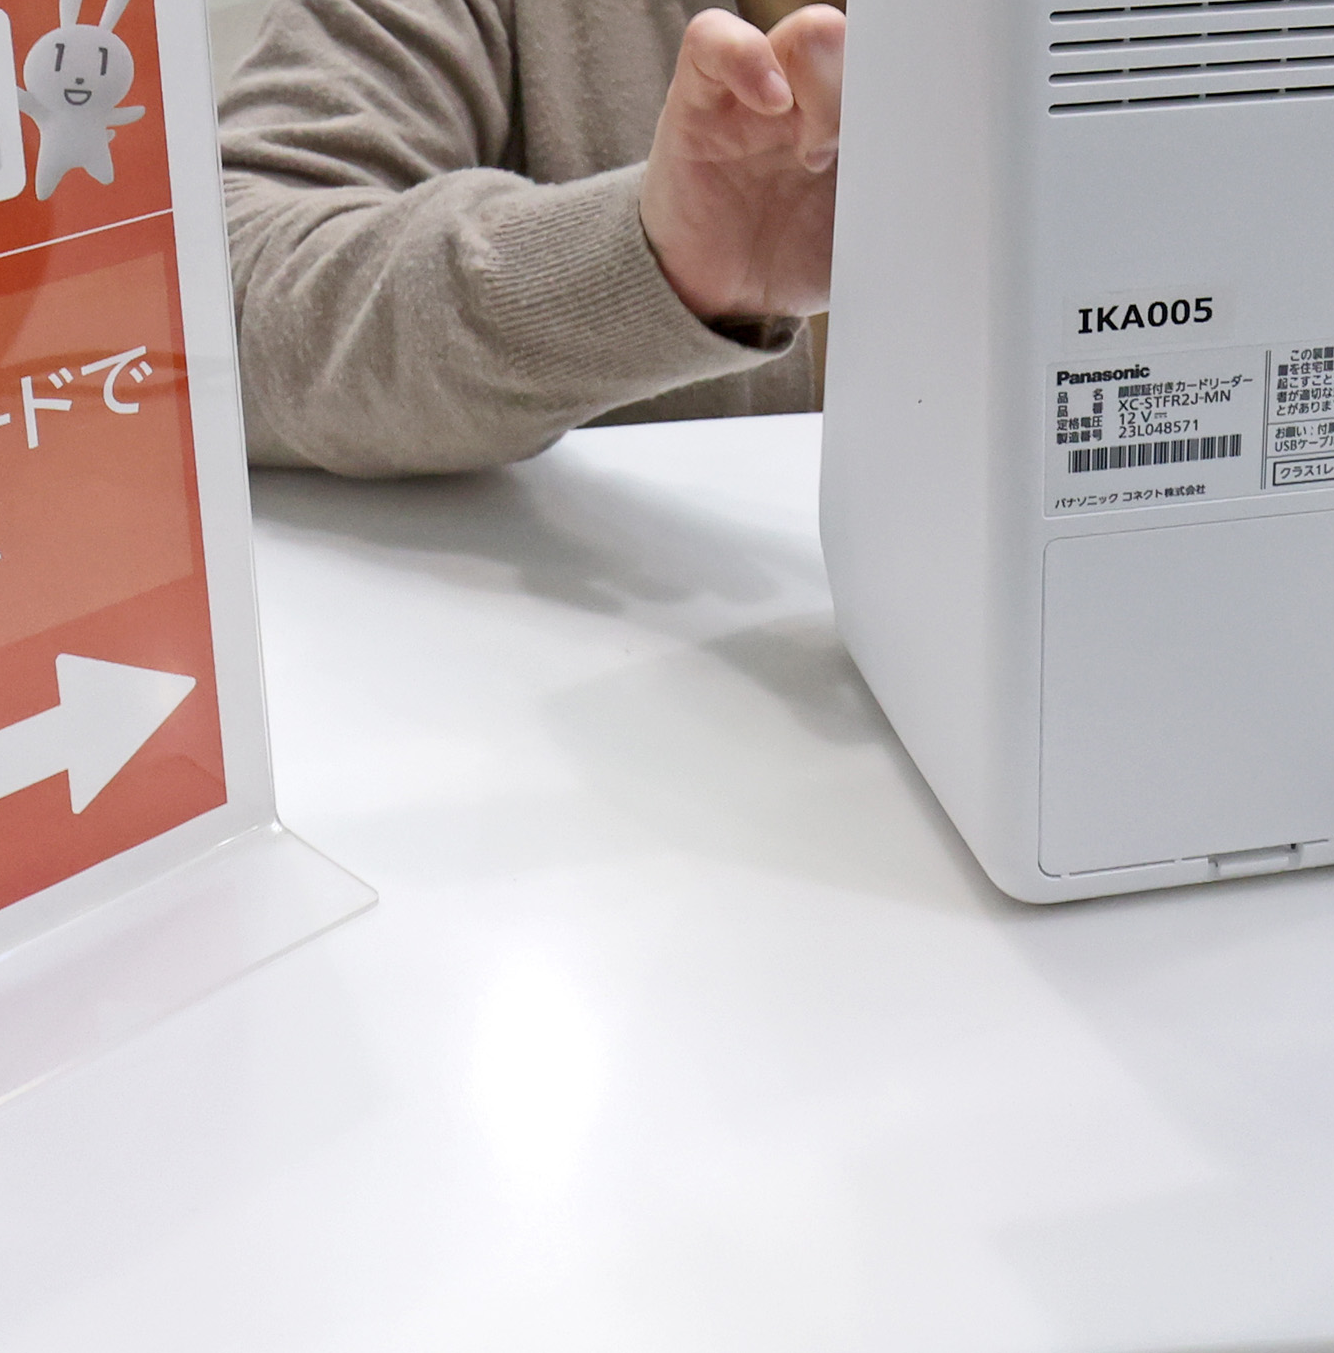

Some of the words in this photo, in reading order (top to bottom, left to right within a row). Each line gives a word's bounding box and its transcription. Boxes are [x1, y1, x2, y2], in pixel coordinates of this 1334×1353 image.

[1078, 297, 1214, 335] IKA005
[1056, 364, 1151, 386] Panasonic
[1118, 390, 1232, 413] XC-STFR2J-MN
[1057, 416, 1103, 431] 定格電圧
[1057, 429, 1102, 445] 製造番号
[1118, 419, 1199, 439] 23L048571
[1122, 484, 1206, 502] コネクト株式会社
